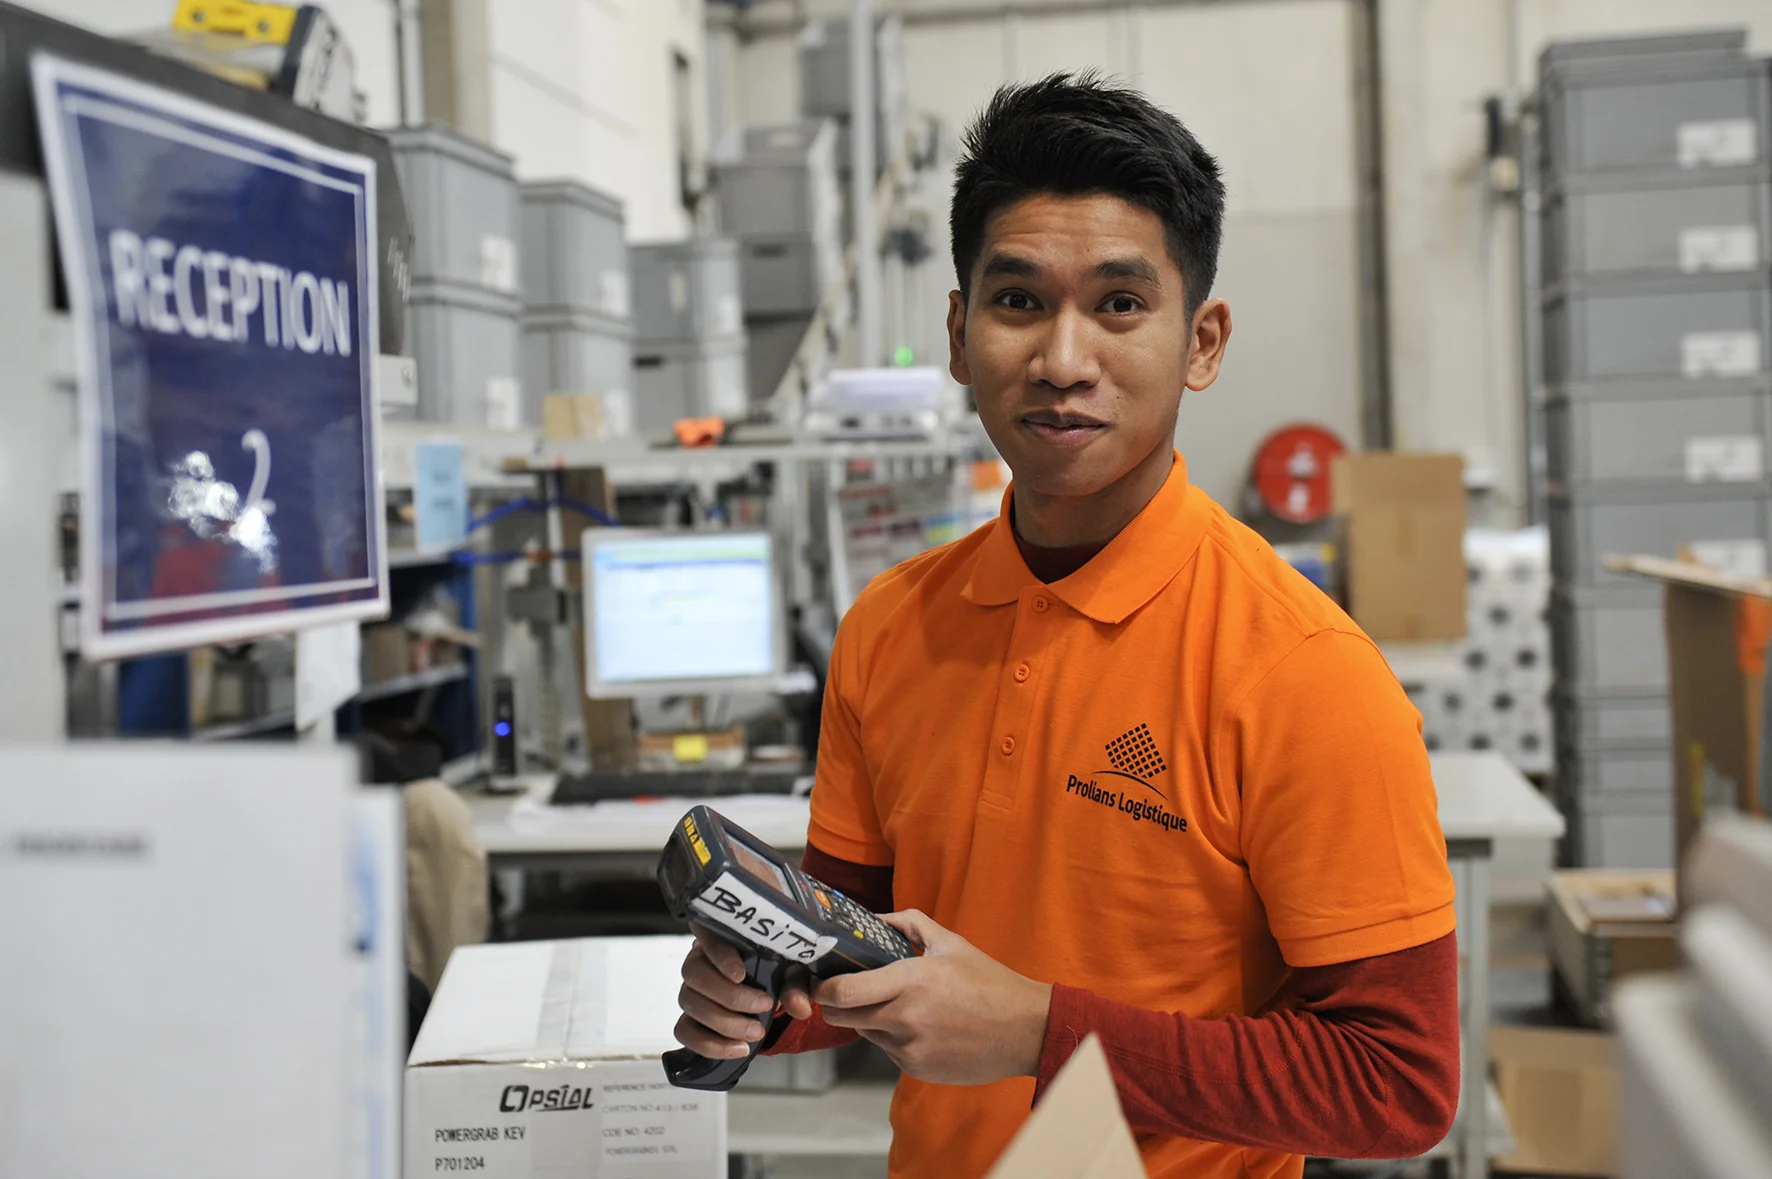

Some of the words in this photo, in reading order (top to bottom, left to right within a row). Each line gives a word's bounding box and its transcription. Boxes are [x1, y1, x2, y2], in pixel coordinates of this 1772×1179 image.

[109, 229, 351, 357] RECEPTION
[240, 427, 278, 516] 2
[1066, 774, 1117, 807] Prolians
[1118, 792, 1188, 832] Logistique
[435, 1128, 499, 1142] POWERGRAB
[504, 1127, 526, 1140] KEV
[435, 1157, 485, 1171] P701204
